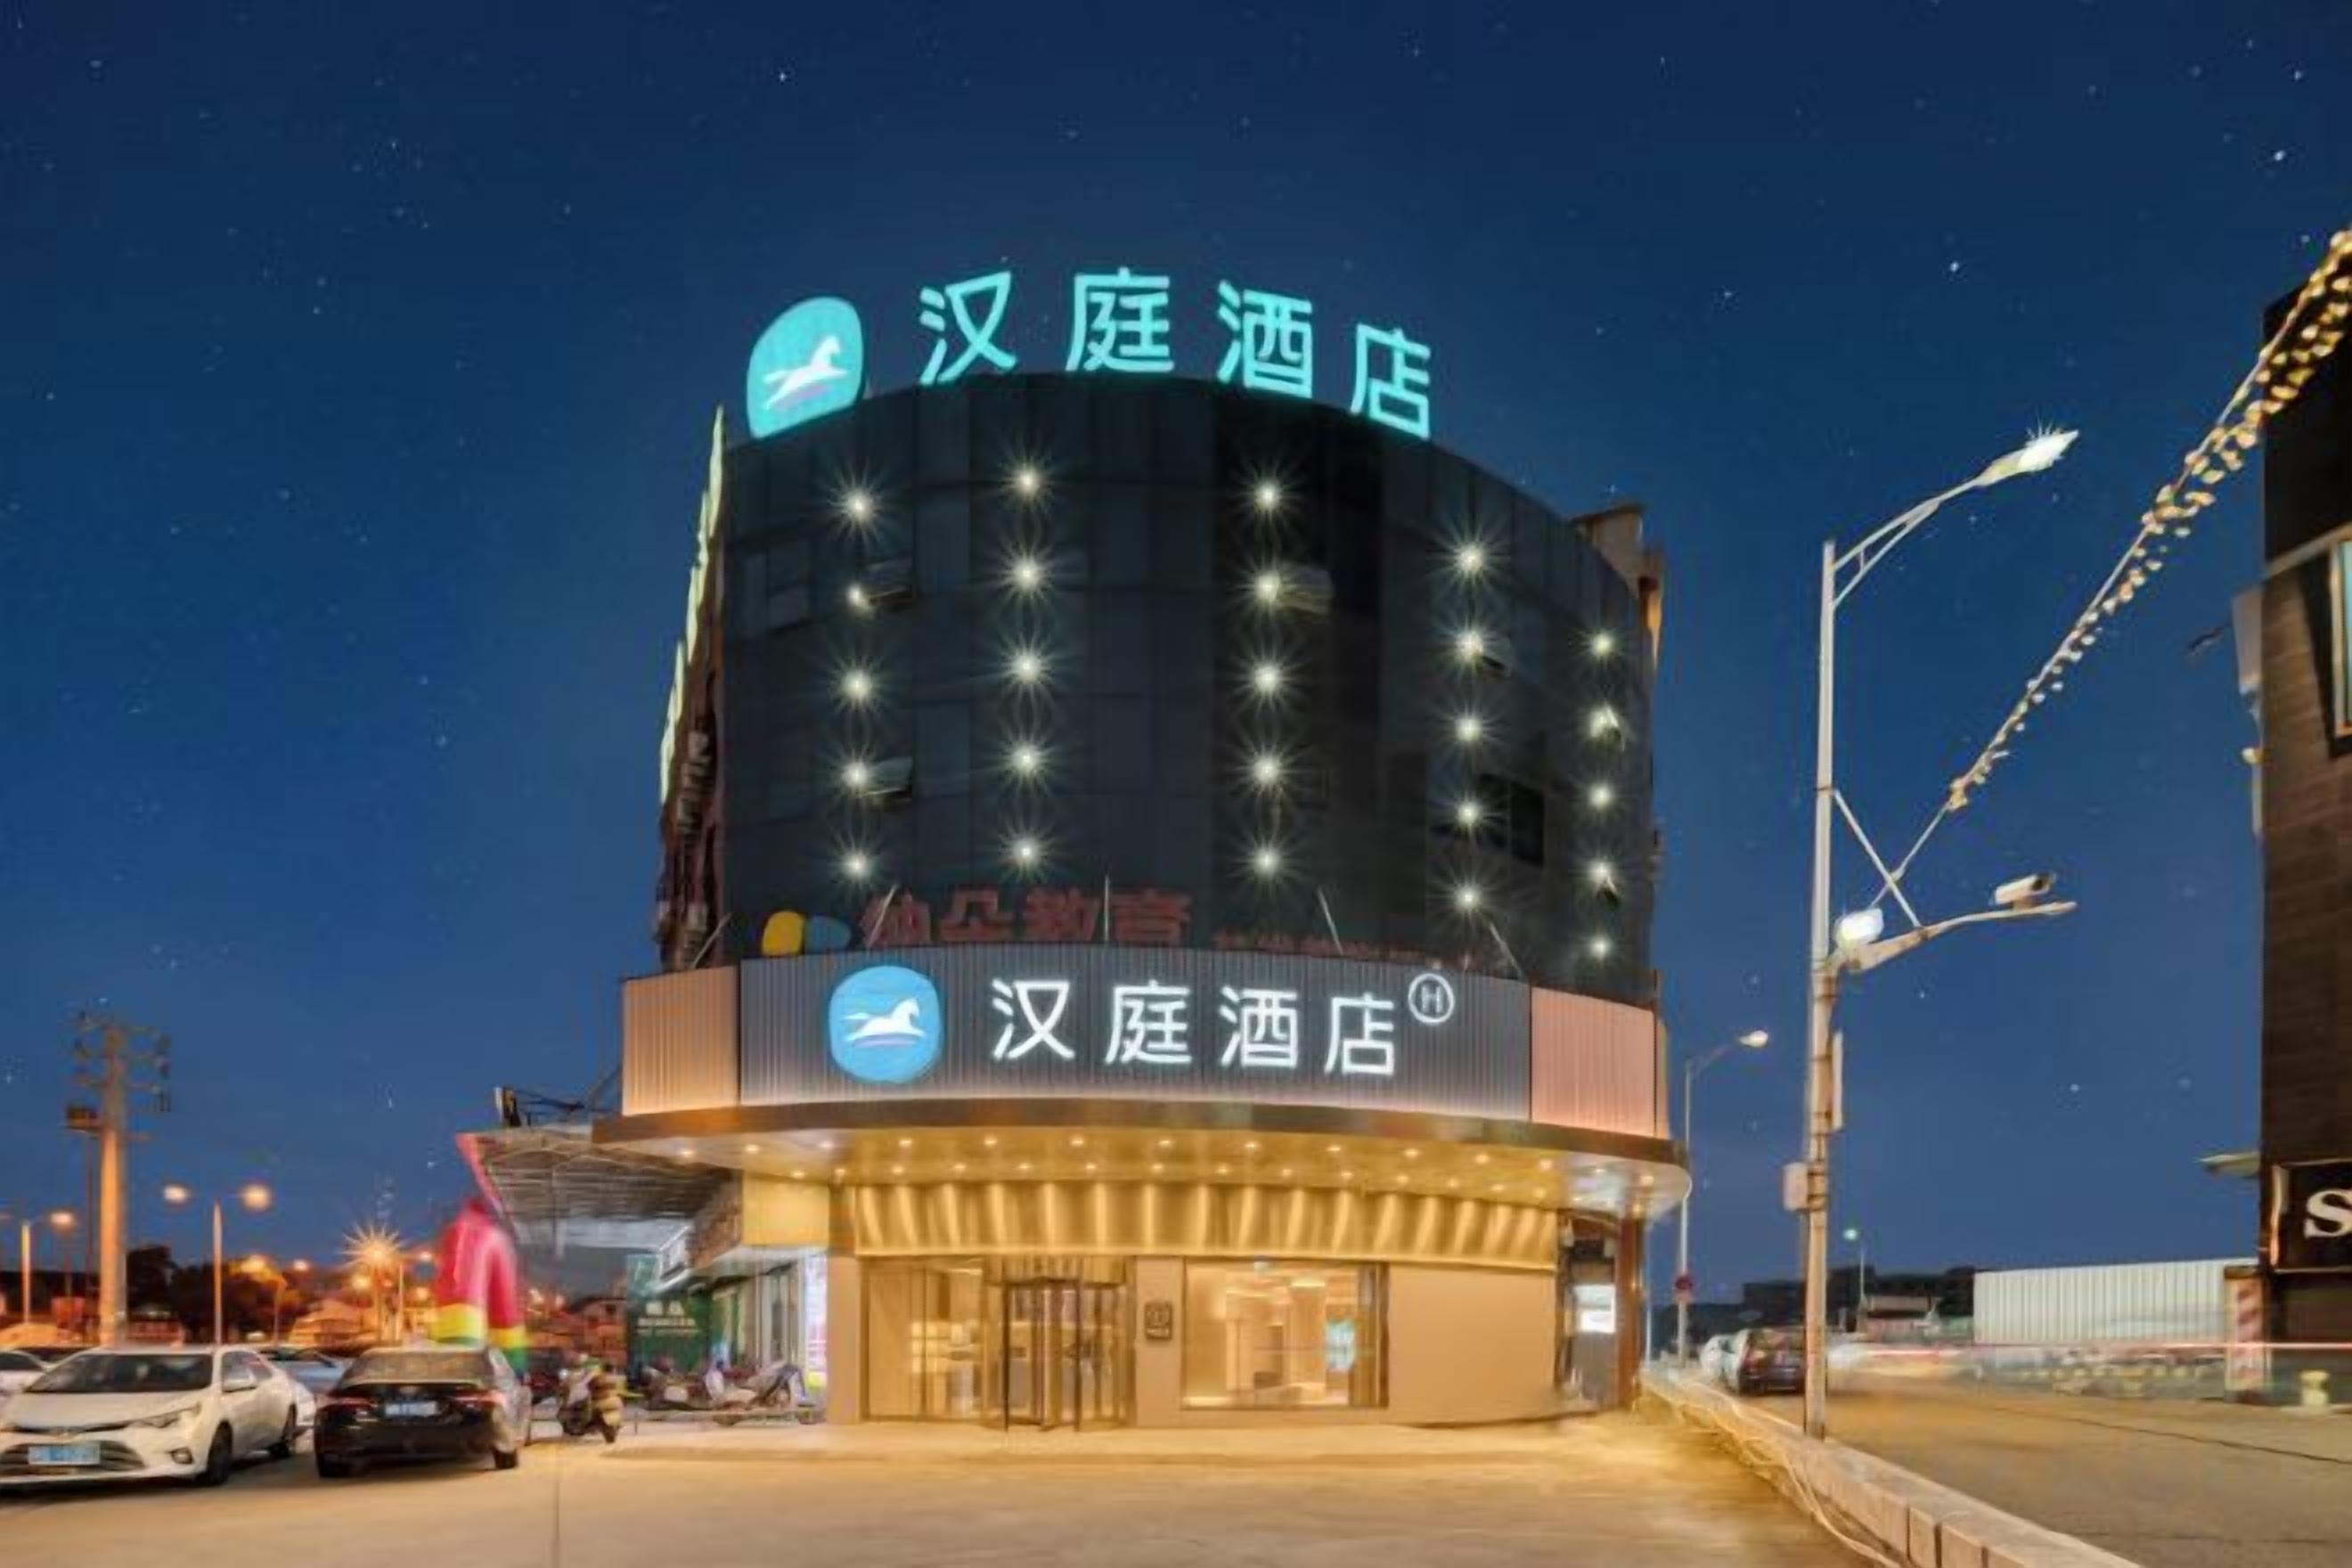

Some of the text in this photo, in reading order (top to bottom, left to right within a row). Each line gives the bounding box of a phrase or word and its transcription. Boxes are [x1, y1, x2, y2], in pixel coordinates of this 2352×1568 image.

[919, 265, 1431, 439] 汉庭酒店
[991, 978, 1395, 1076] 汉庭酒店
